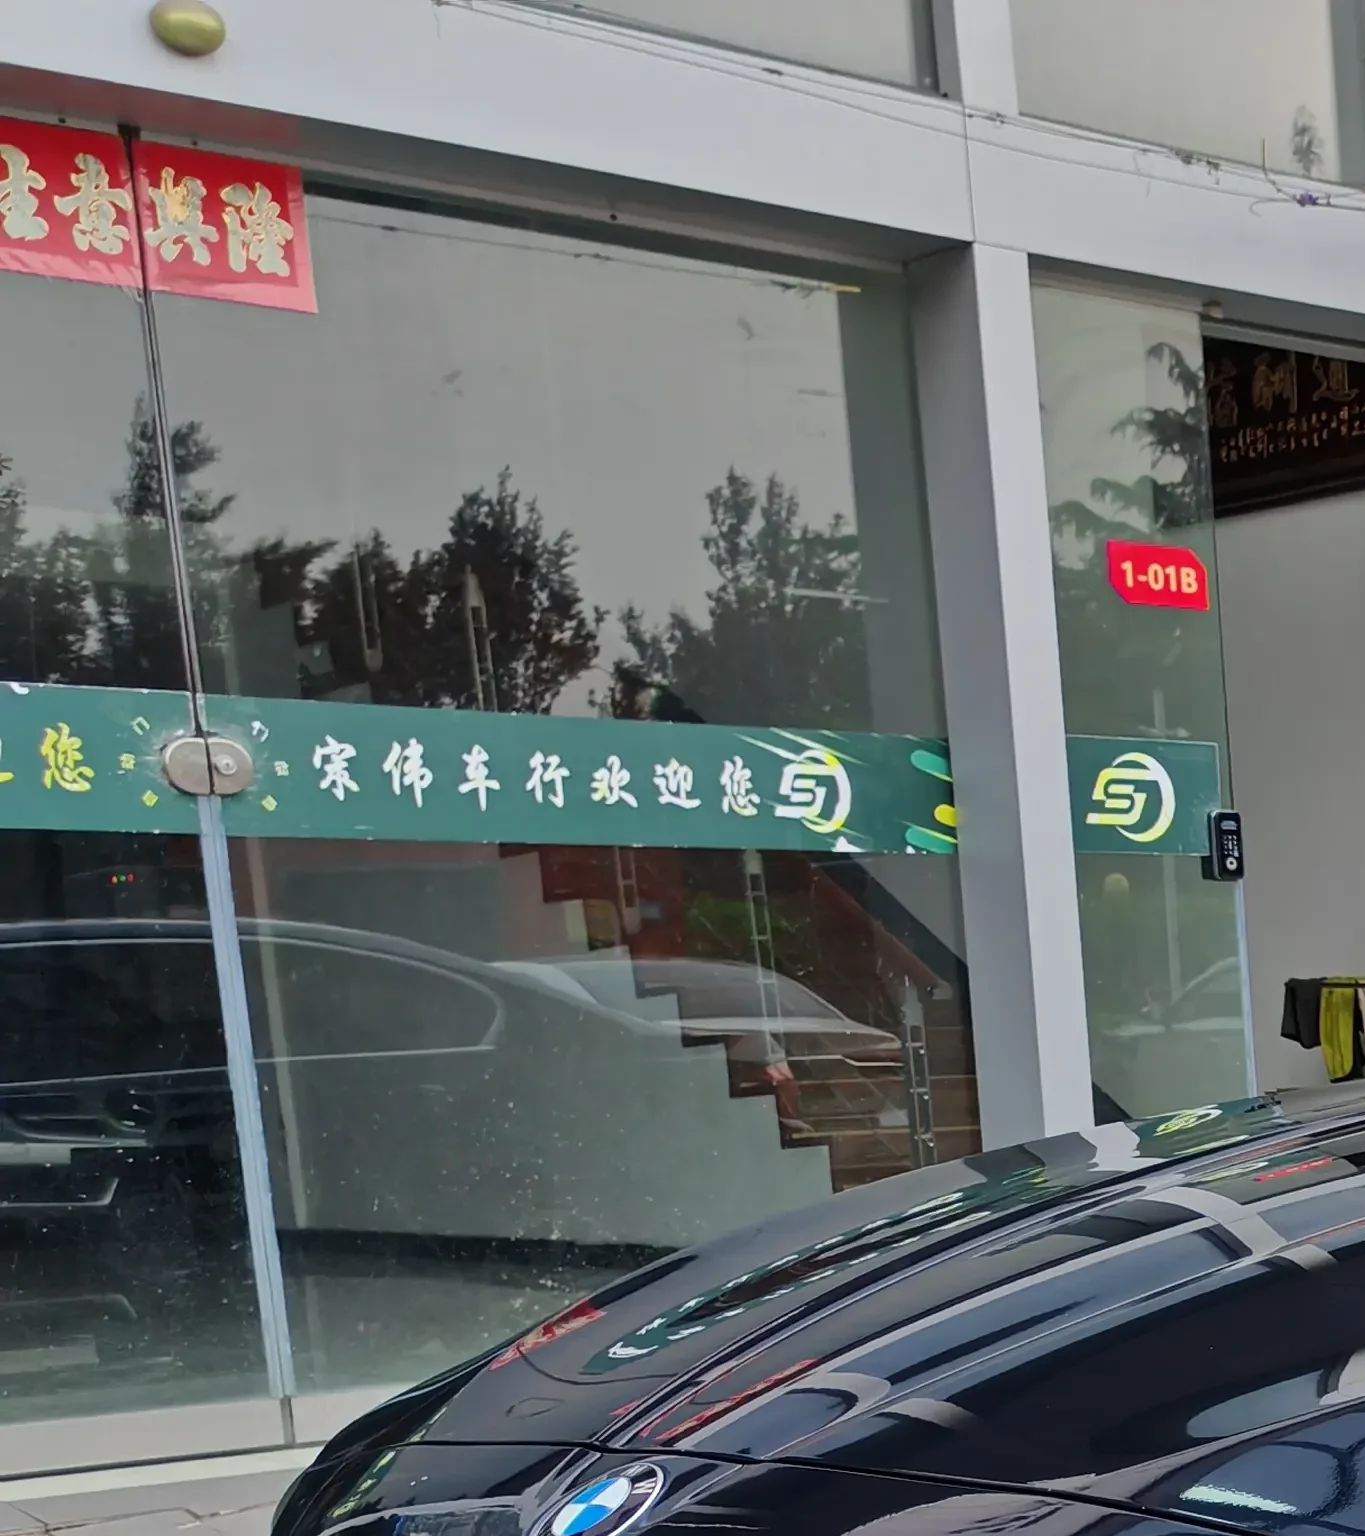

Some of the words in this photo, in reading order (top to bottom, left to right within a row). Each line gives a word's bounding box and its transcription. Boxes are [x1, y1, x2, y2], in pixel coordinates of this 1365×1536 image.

[1119, 560, 1199, 595] 1-01B
[0, 722, 95, 792] 您
[312, 734, 760, 817] 宋伟车行欢迎您
